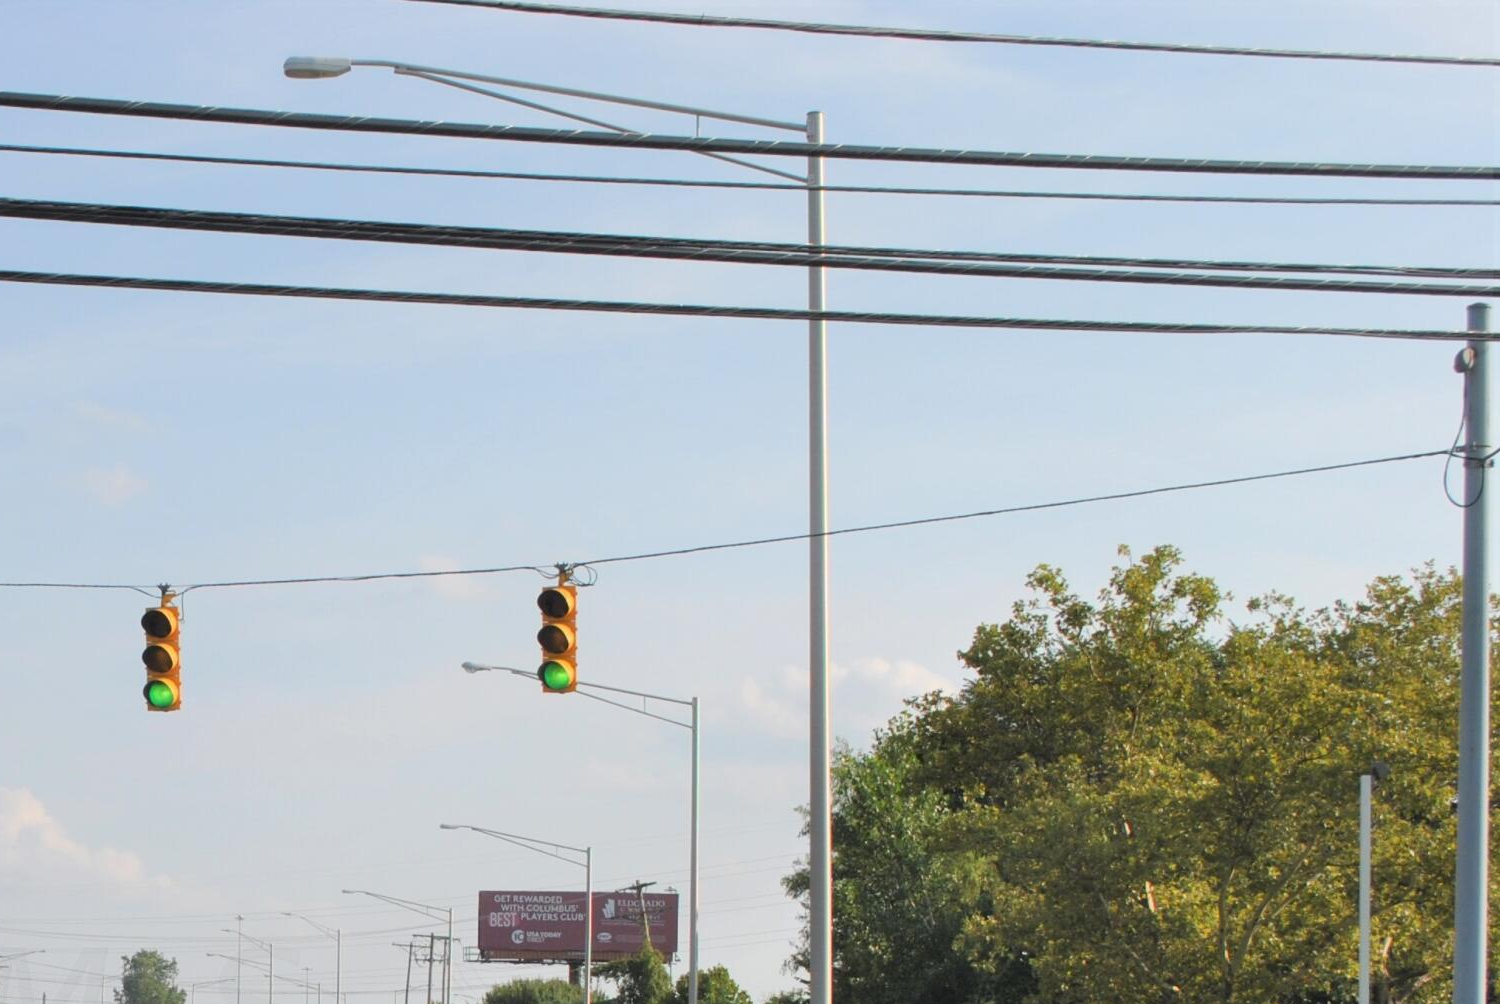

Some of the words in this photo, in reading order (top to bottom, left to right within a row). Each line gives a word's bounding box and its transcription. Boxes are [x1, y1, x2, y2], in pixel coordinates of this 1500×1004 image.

[494, 895, 510, 903] GET
[513, 895, 563, 904] REWARDED
[501, 904, 524, 912] WITH
[489, 912, 517, 927] BEST
[521, 913, 558, 921] PLAYERS
